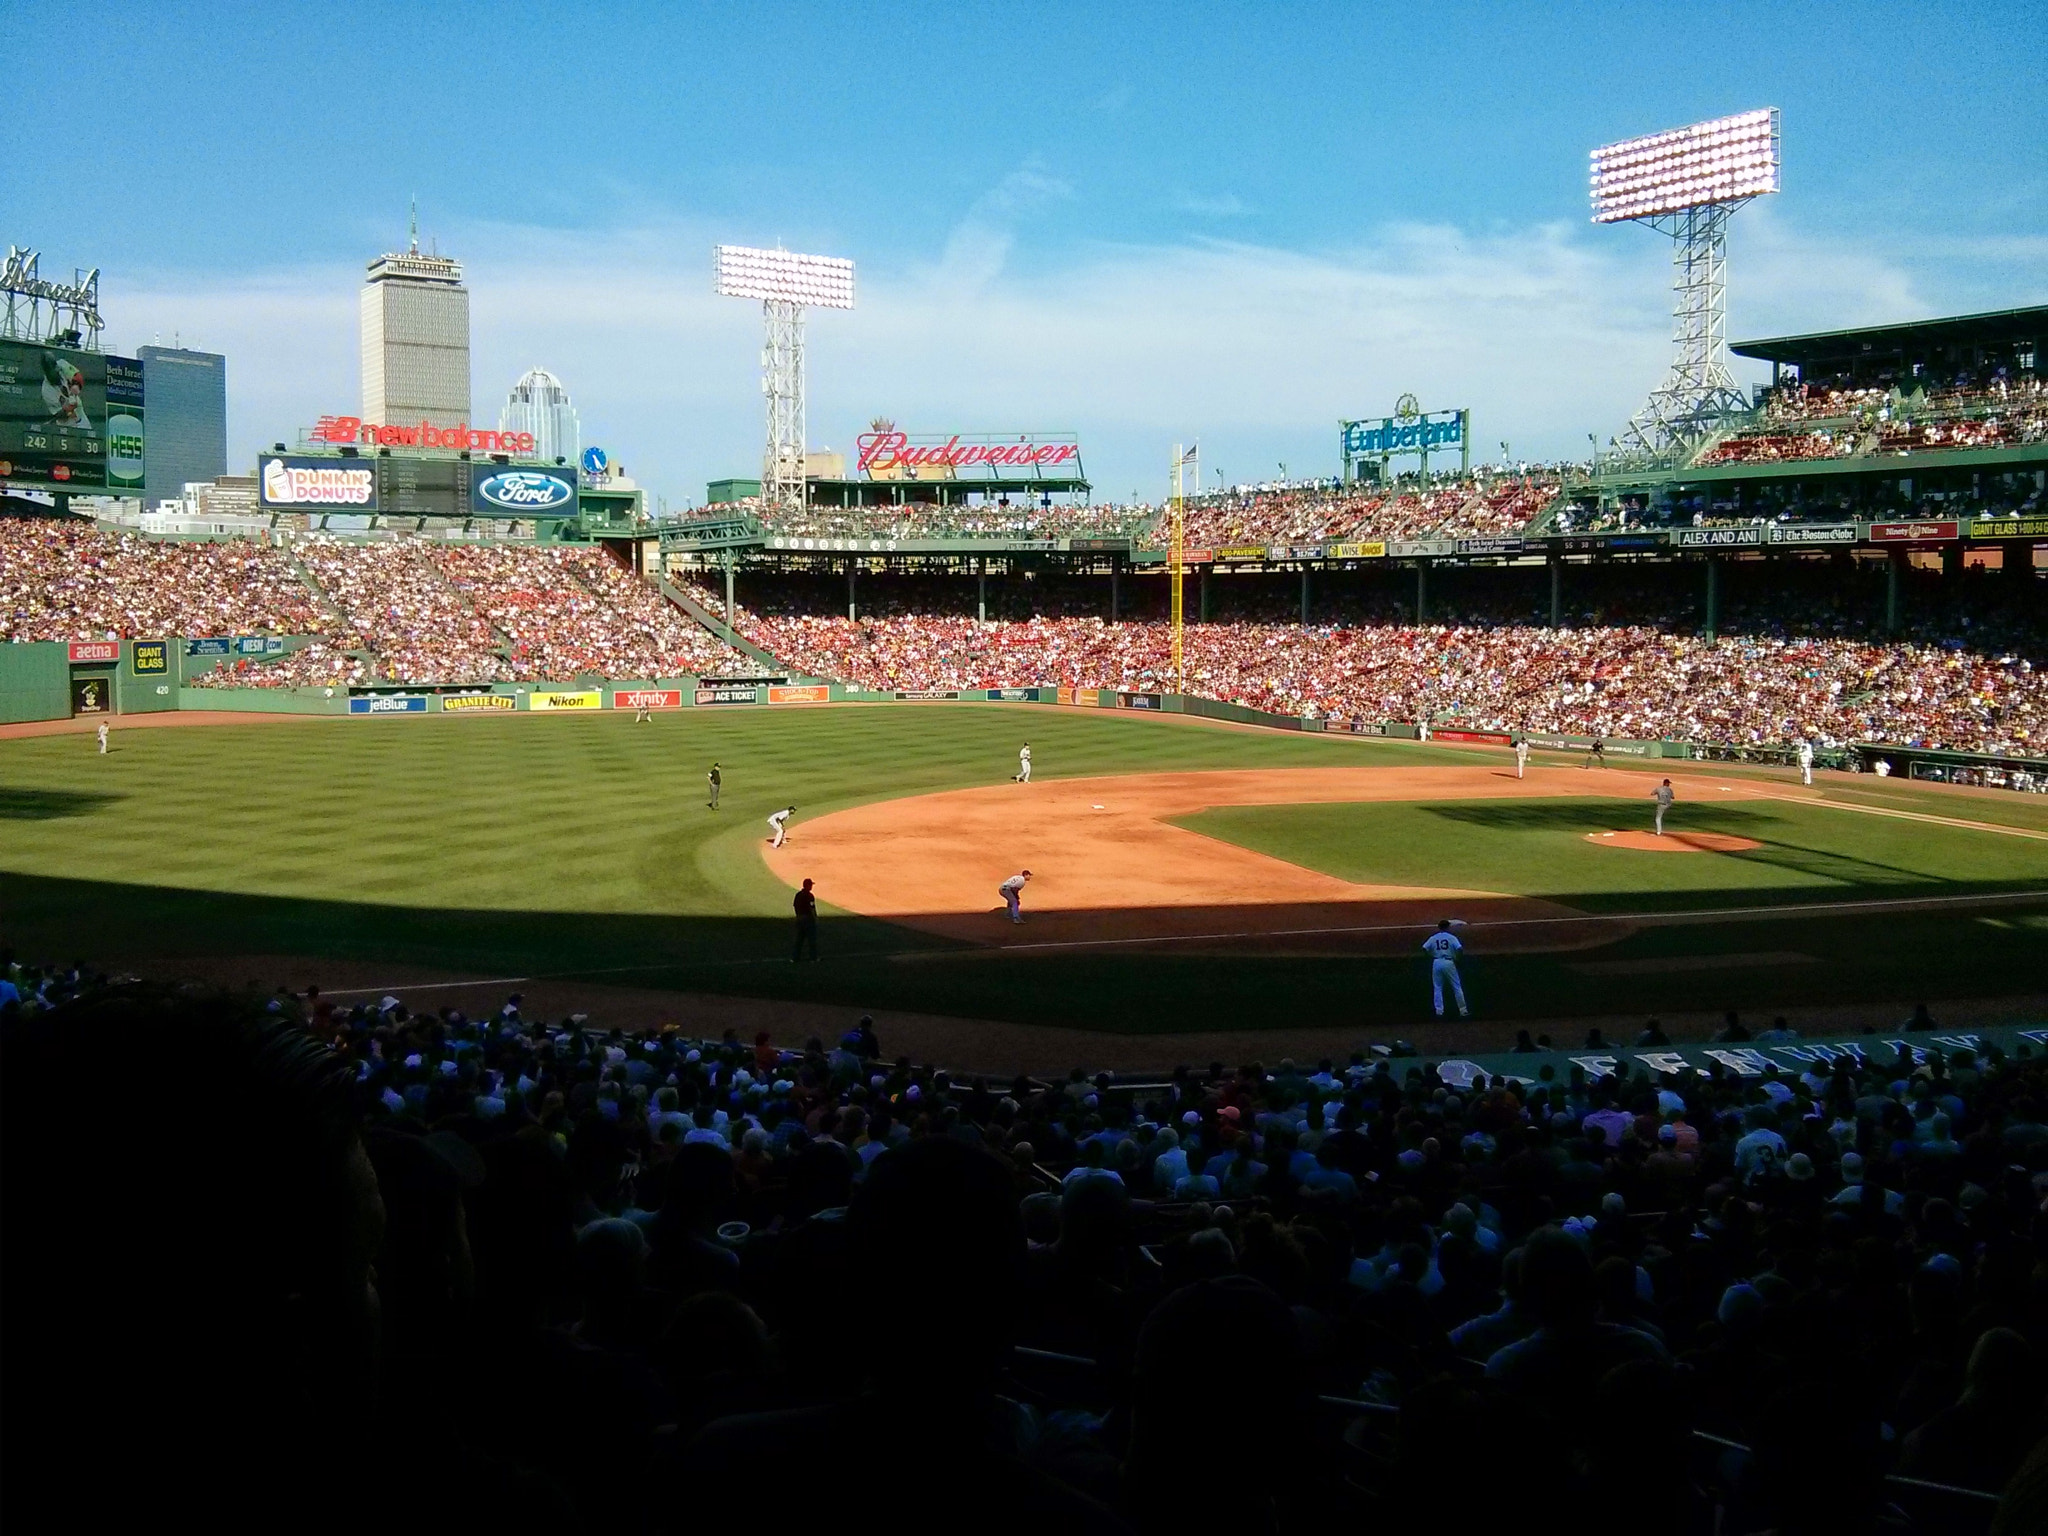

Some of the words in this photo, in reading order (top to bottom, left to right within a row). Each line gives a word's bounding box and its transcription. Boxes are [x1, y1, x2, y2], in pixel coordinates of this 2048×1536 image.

[399, 262, 450, 272] PRUDENTIAL
[107, 364, 122, 376] Beth
[124, 367, 143, 378] Israel
[422, 420, 534, 450] balance
[1345, 412, 1461, 452] Cumberland
[24, 436, 46, 448] .242
[61, 440, 67, 450] 5
[86, 442, 98, 453] 30
[110, 434, 142, 460] HESS
[856, 432, 1078, 471] Budweiser
[296, 472, 368, 485] DUNKIN'
[296, 487, 366, 500] DONUTS
[498, 478, 554, 502] Ford
[1786, 531, 1800, 541] The
[1801, 530, 1829, 540] Boston
[1830, 529, 1854, 539] Globe
[1974, 524, 1993, 535] GIANT
[1995, 523, 2017, 534] GLASS
[1683, 533, 1709, 544] ALEX
[1709, 532, 1735, 543] AND
[1737, 531, 1757, 542] ANI
[76, 644, 112, 658] aetna
[138, 647, 162, 657] GIANT
[243, 640, 264, 652] NESN
[138, 658, 164, 668] GLASS
[156, 686, 169, 694] 420
[716, 691, 730, 701] ACE
[731, 691, 755, 700] TICKET
[369, 699, 408, 712] jetBlue
[444, 696, 490, 710] GRANITE
[492, 696, 515, 709] CITY
[548, 696, 584, 707] Nikon
[627, 692, 668, 707] xfinity
[1436, 940, 1449, 950] 13
